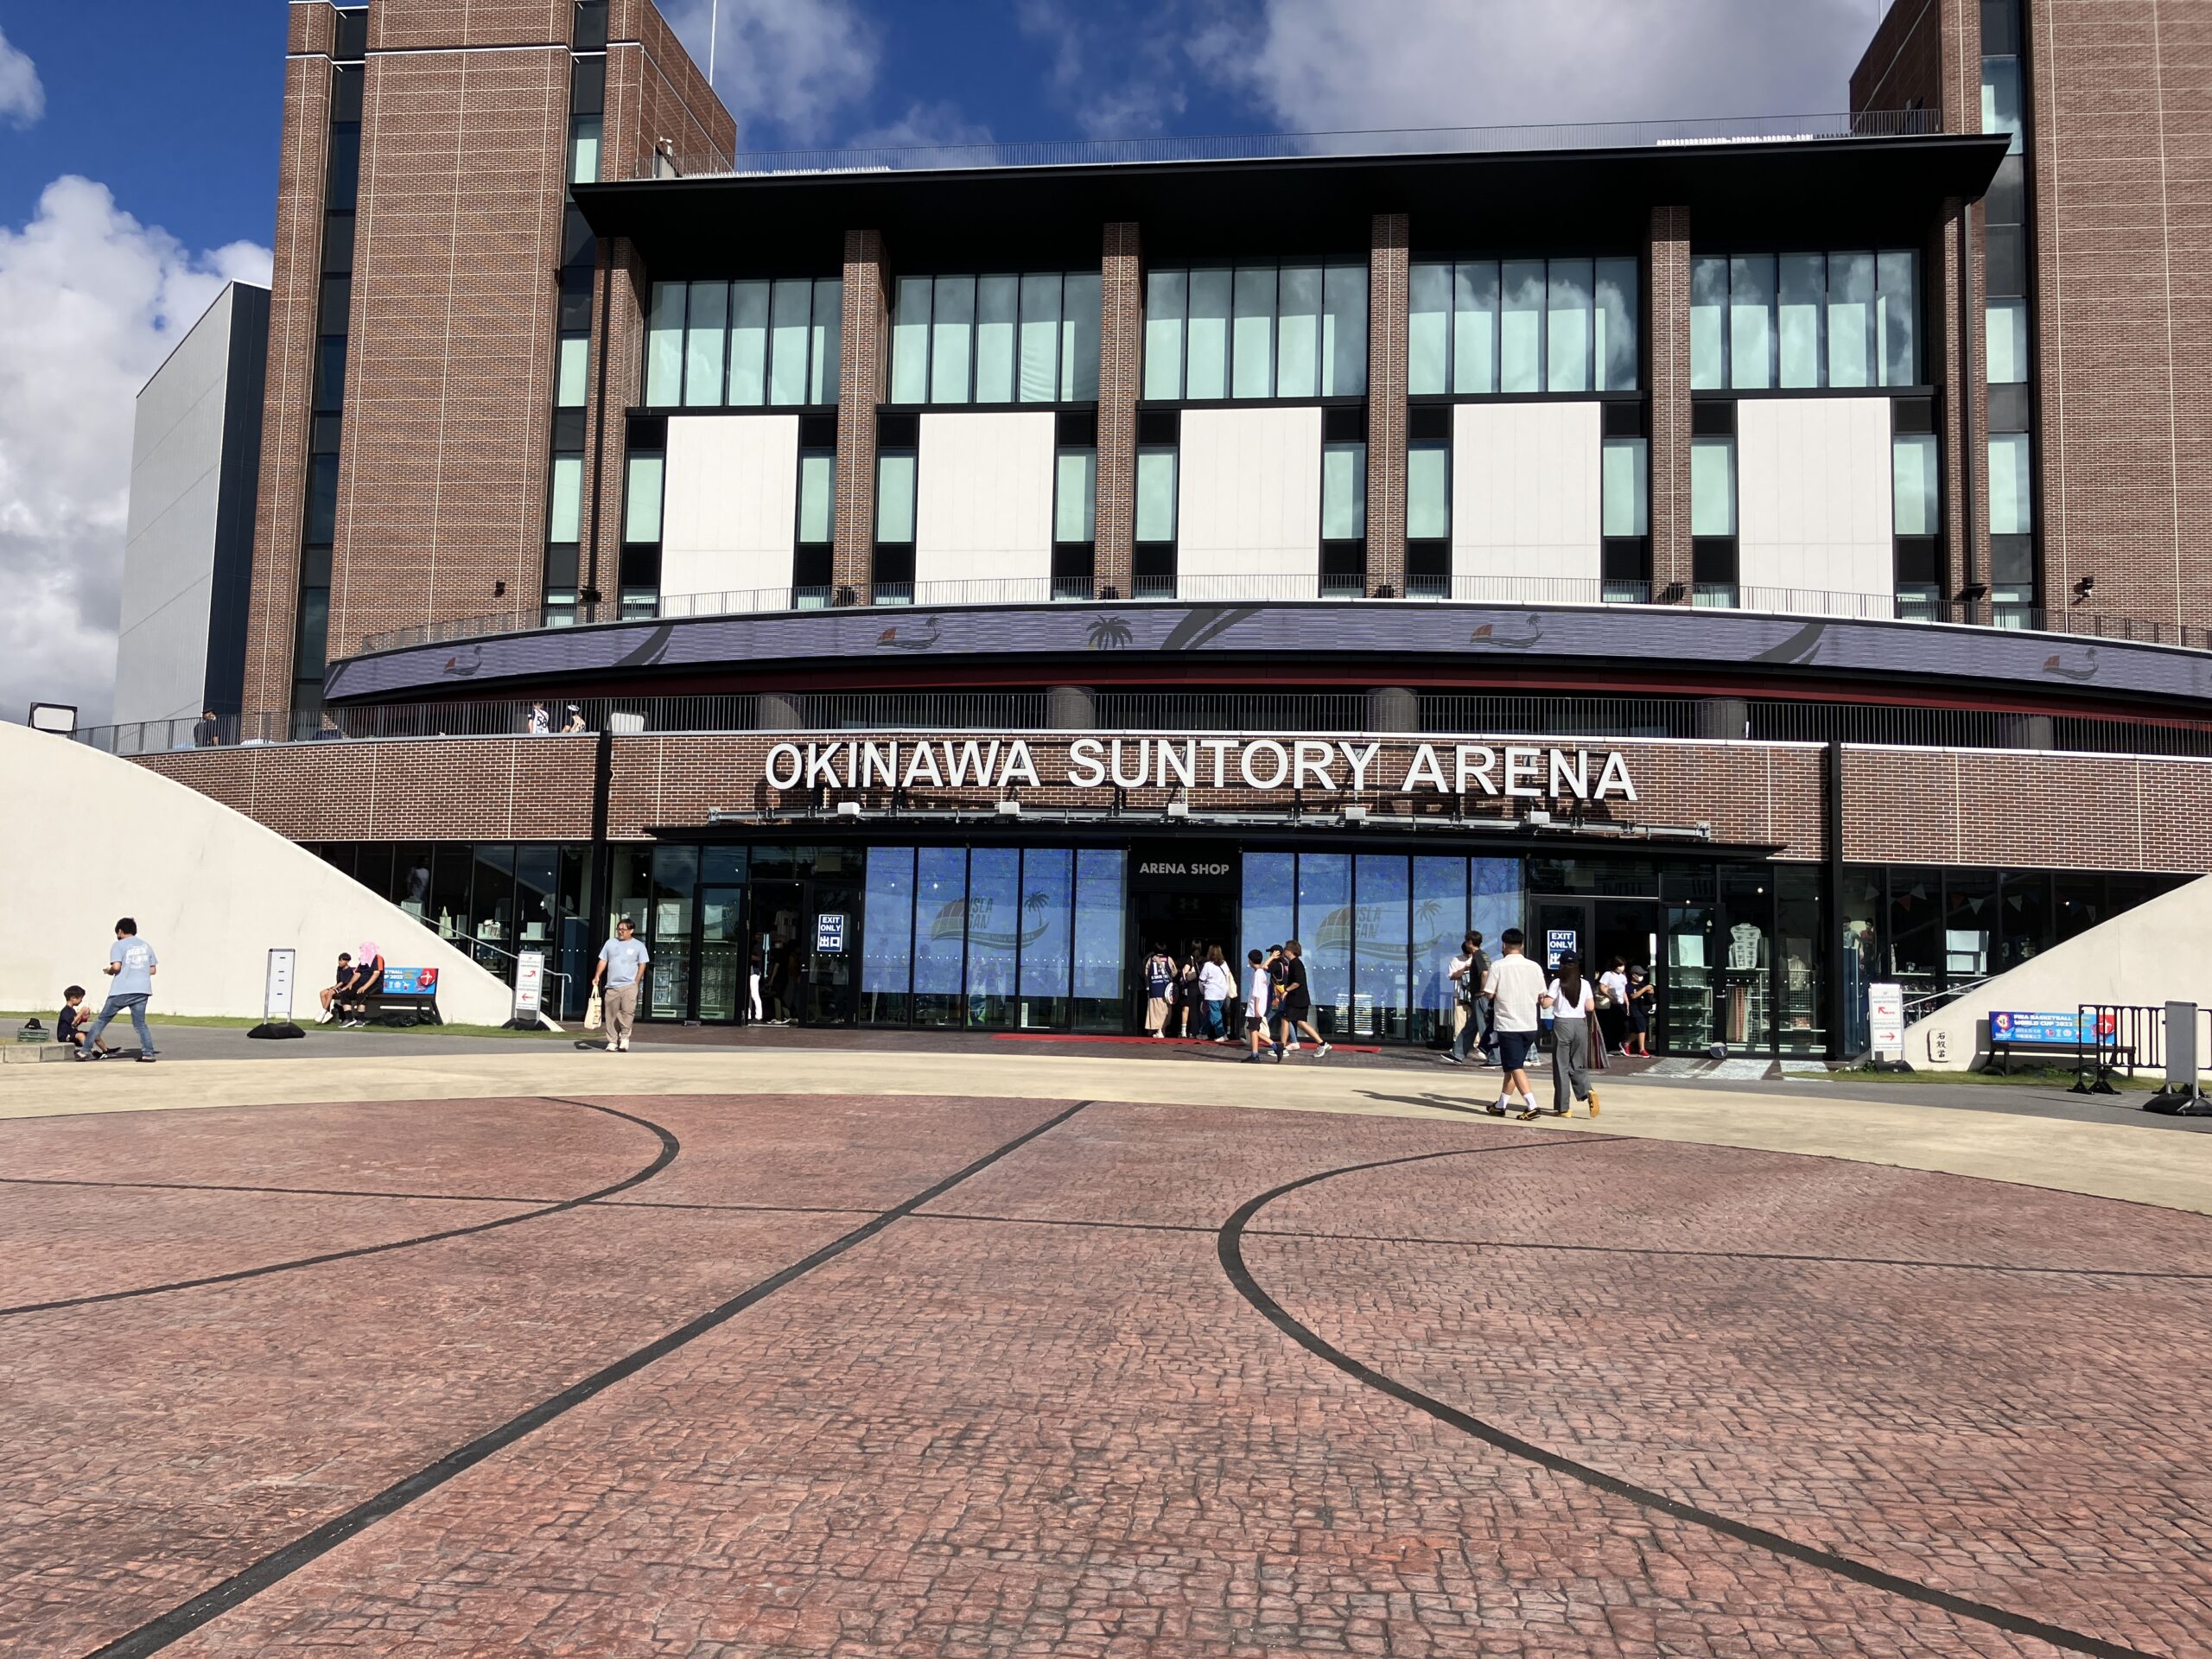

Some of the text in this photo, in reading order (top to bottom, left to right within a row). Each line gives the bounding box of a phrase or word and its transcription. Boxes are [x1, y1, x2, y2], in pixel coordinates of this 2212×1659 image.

[765, 738, 1638, 801] OKINAWA SUNTORY ARENA
[1139, 862, 1230, 875] ARENA SHOP
[819, 935, 841, 948] 出口
[1549, 940, 1573, 949] ONLY
[1549, 952, 1561, 965] 出
